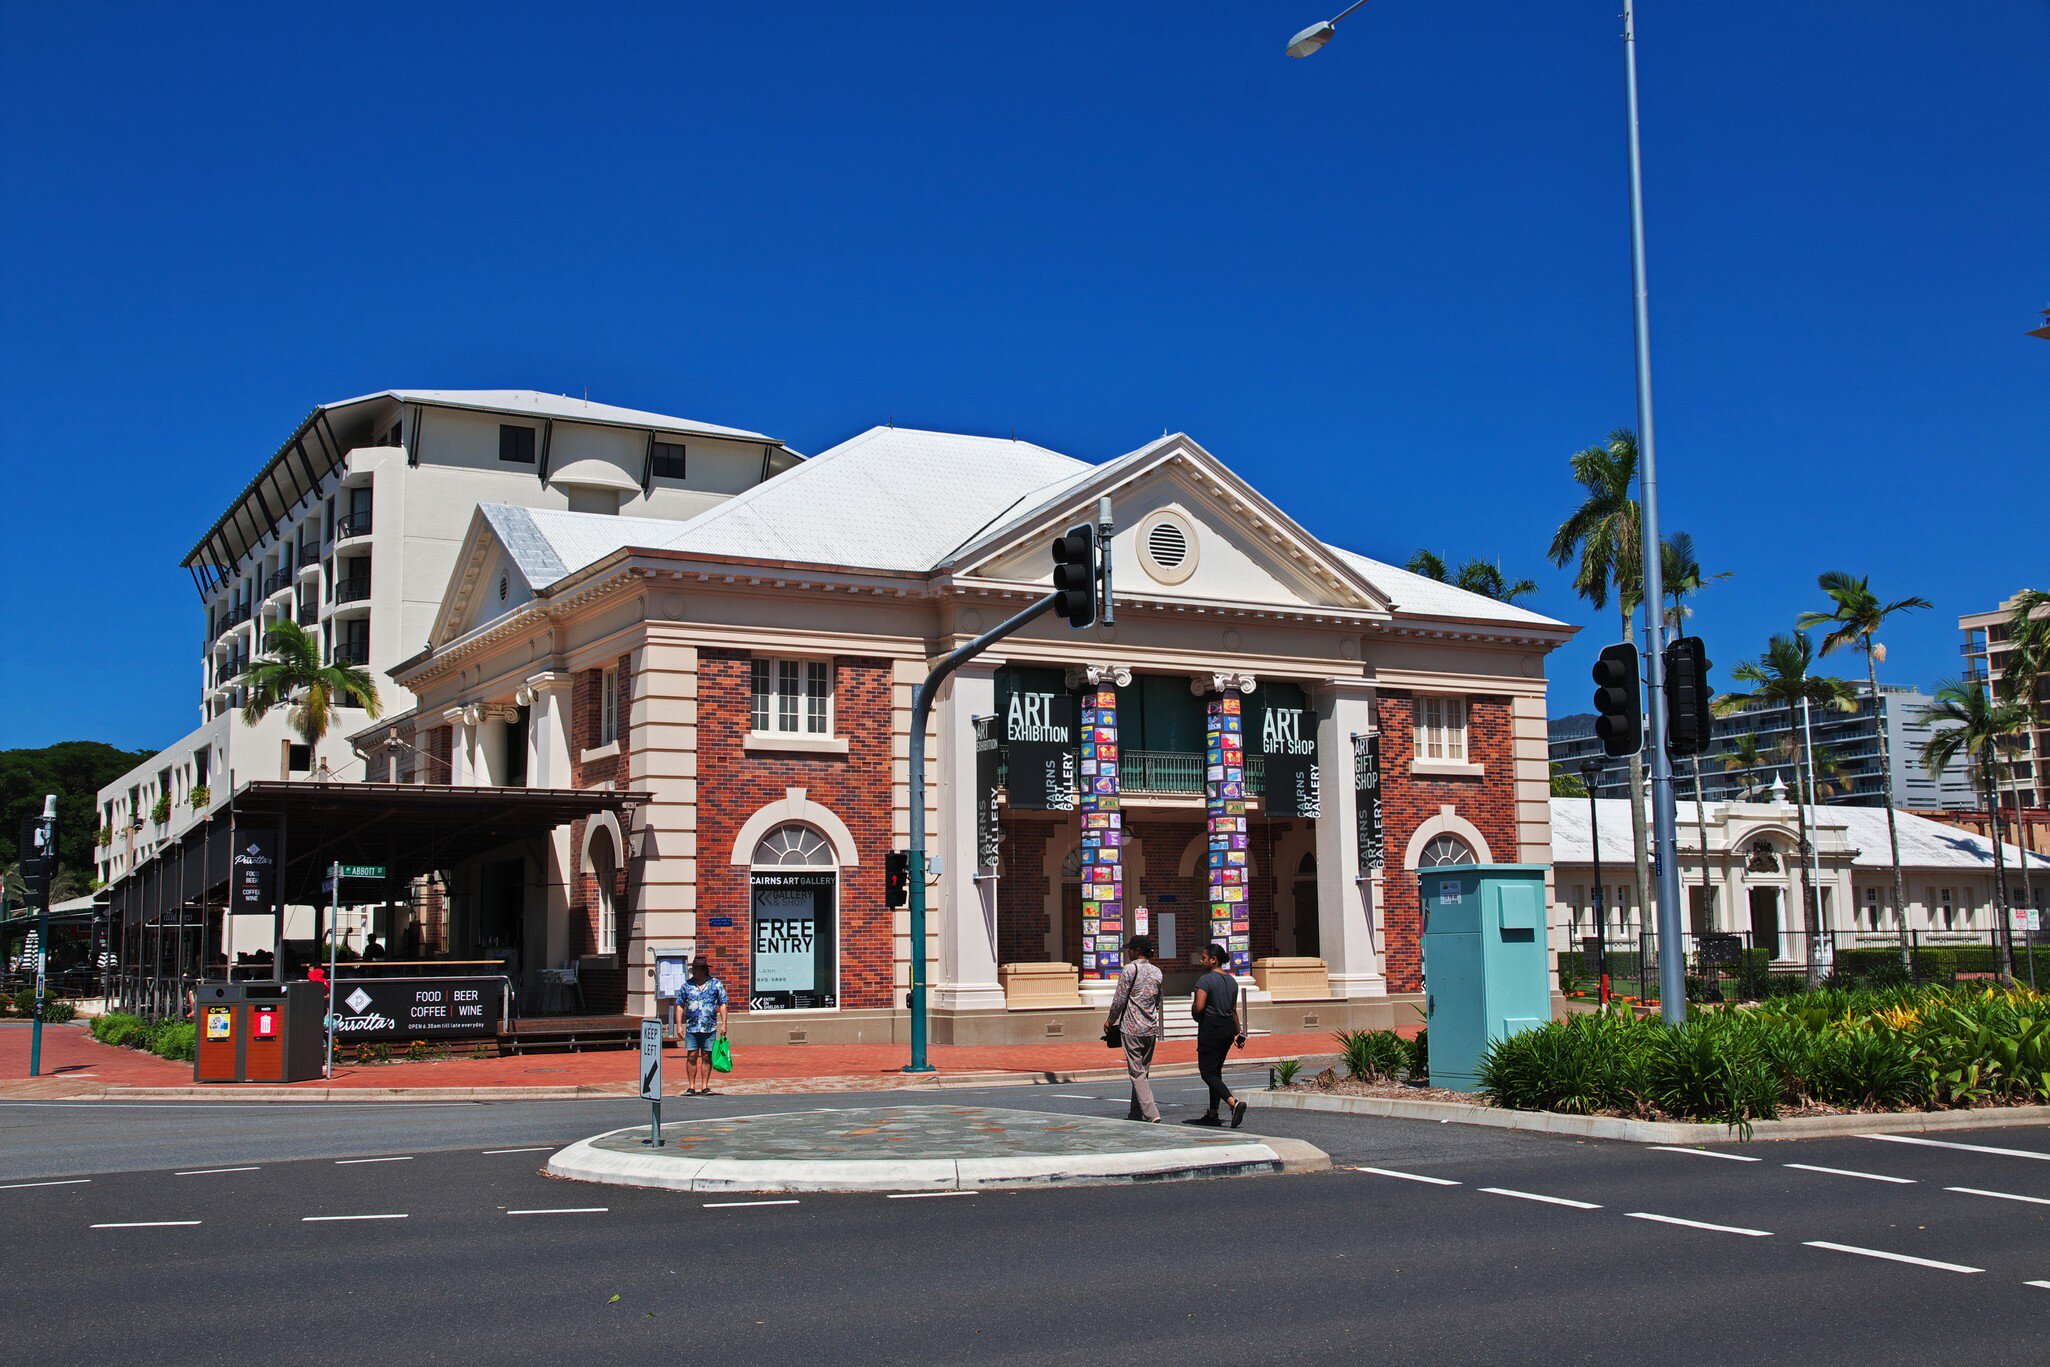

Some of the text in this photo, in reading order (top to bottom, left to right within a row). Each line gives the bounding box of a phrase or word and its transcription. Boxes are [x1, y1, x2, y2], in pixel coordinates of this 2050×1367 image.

[1008, 692, 1054, 727] ART
[976, 721, 988, 740] ART
[1263, 708, 1302, 740] ART
[1008, 726, 1068, 742] EXHIBITION
[976, 739, 998, 752] EXHIBITION
[1263, 739, 1314, 754] GIFT SHOP
[1355, 739, 1369, 757] ART
[1355, 755, 1373, 773] GIFT
[1046, 760, 1055, 810] CAIRNS
[1063, 752, 1073, 811] GALLERY
[1355, 772, 1378, 790] SHOP
[1055, 785, 1064, 810] ART
[1296, 772, 1304, 817] CAIRNS
[1310, 764, 1320, 818] GALLERY
[1304, 794, 1312, 818] ART
[979, 800, 987, 866] CAIRNS
[991, 787, 999, 866] GALLERY
[1373, 798, 1384, 869] GALLERY
[1360, 809, 1368, 870] CAIRNS
[1368, 838, 1376, 869] ART
[352, 867, 375, 875] ABBOTT
[750, 877, 781, 885] CAIRNS
[783, 877, 799, 885] ART
[773, 891, 812, 899] GALLERY
[757, 918, 813, 938] FREE
[757, 938, 812, 953] ENTRY
[416, 990, 478, 1001] FOOD BEER
[411, 1005, 482, 1017] COFFEE WINE
[333, 1012, 394, 1031] Perrotta's
[645, 1028, 658, 1040] KEEP
[645, 1044, 657, 1056] LEFT
